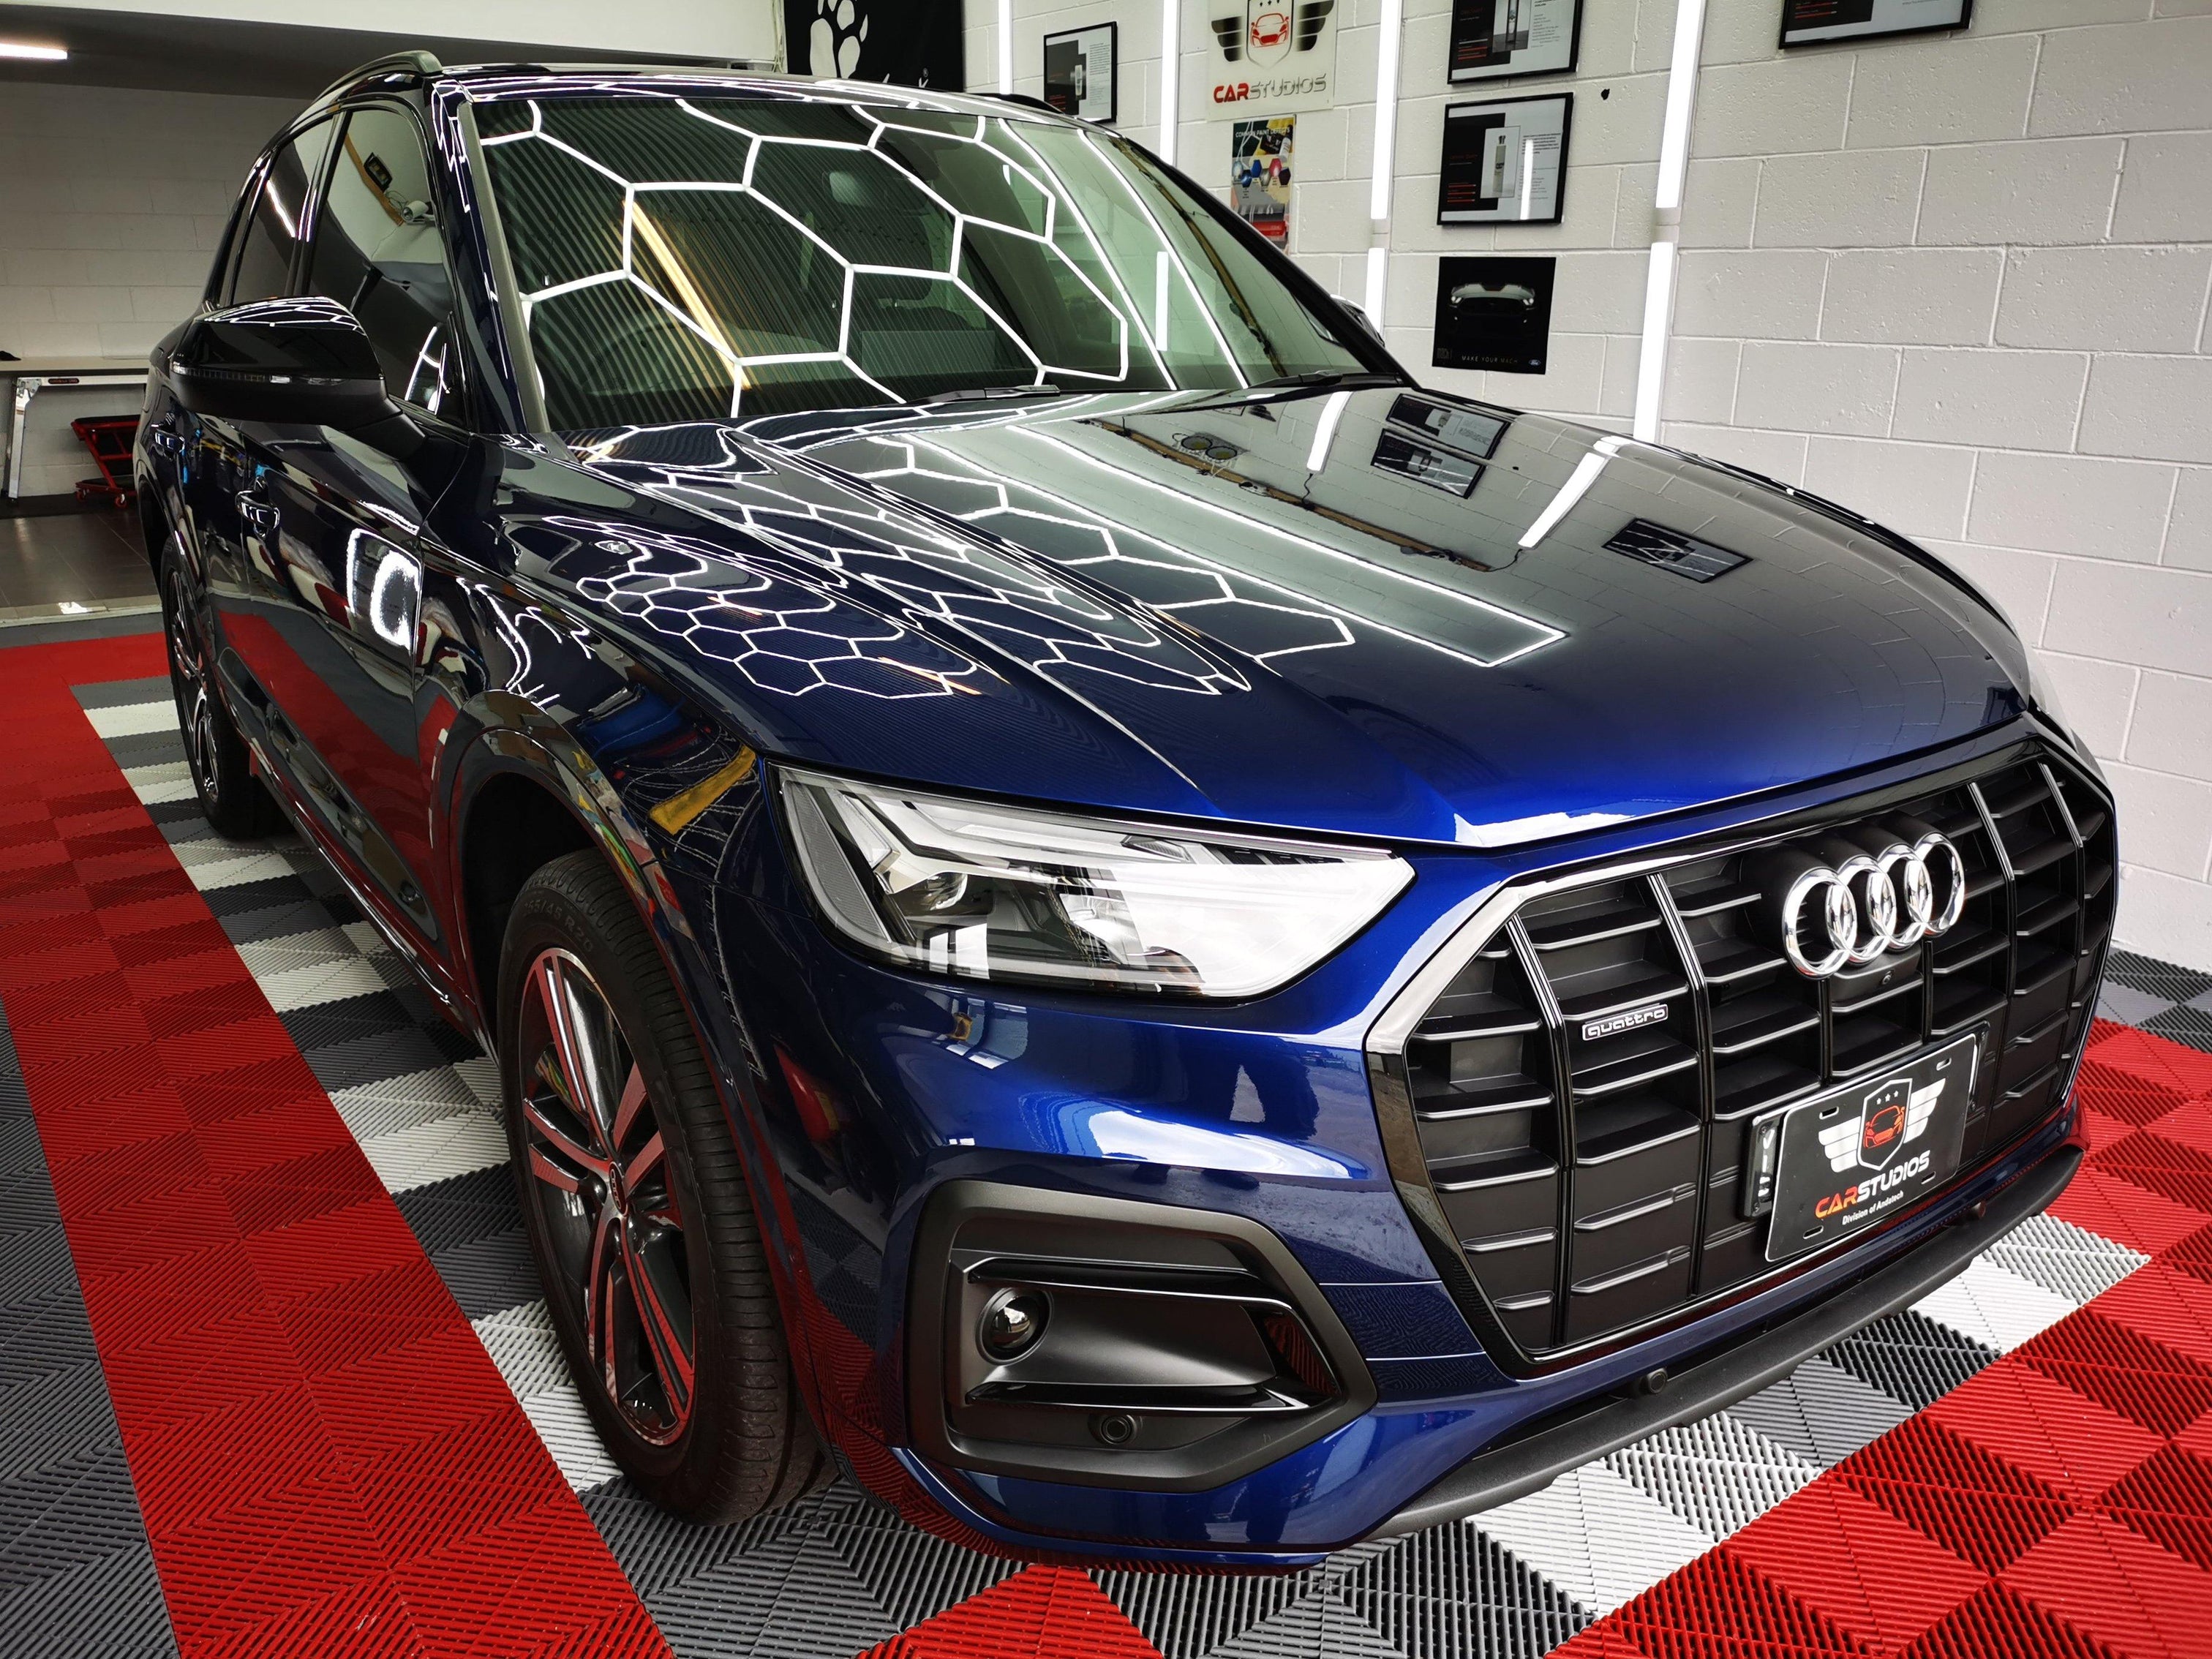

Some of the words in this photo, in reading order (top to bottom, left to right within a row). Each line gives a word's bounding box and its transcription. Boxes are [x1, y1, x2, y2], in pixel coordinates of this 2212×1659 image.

[1213, 73, 1327, 103] CARSTUDIOS
[1587, 1009, 1666, 1037] quattro
[1815, 1150, 1930, 1219] CARSTUDIOS
[1842, 1209, 1868, 1225] Division
[1869, 1203, 1876, 1214] of
